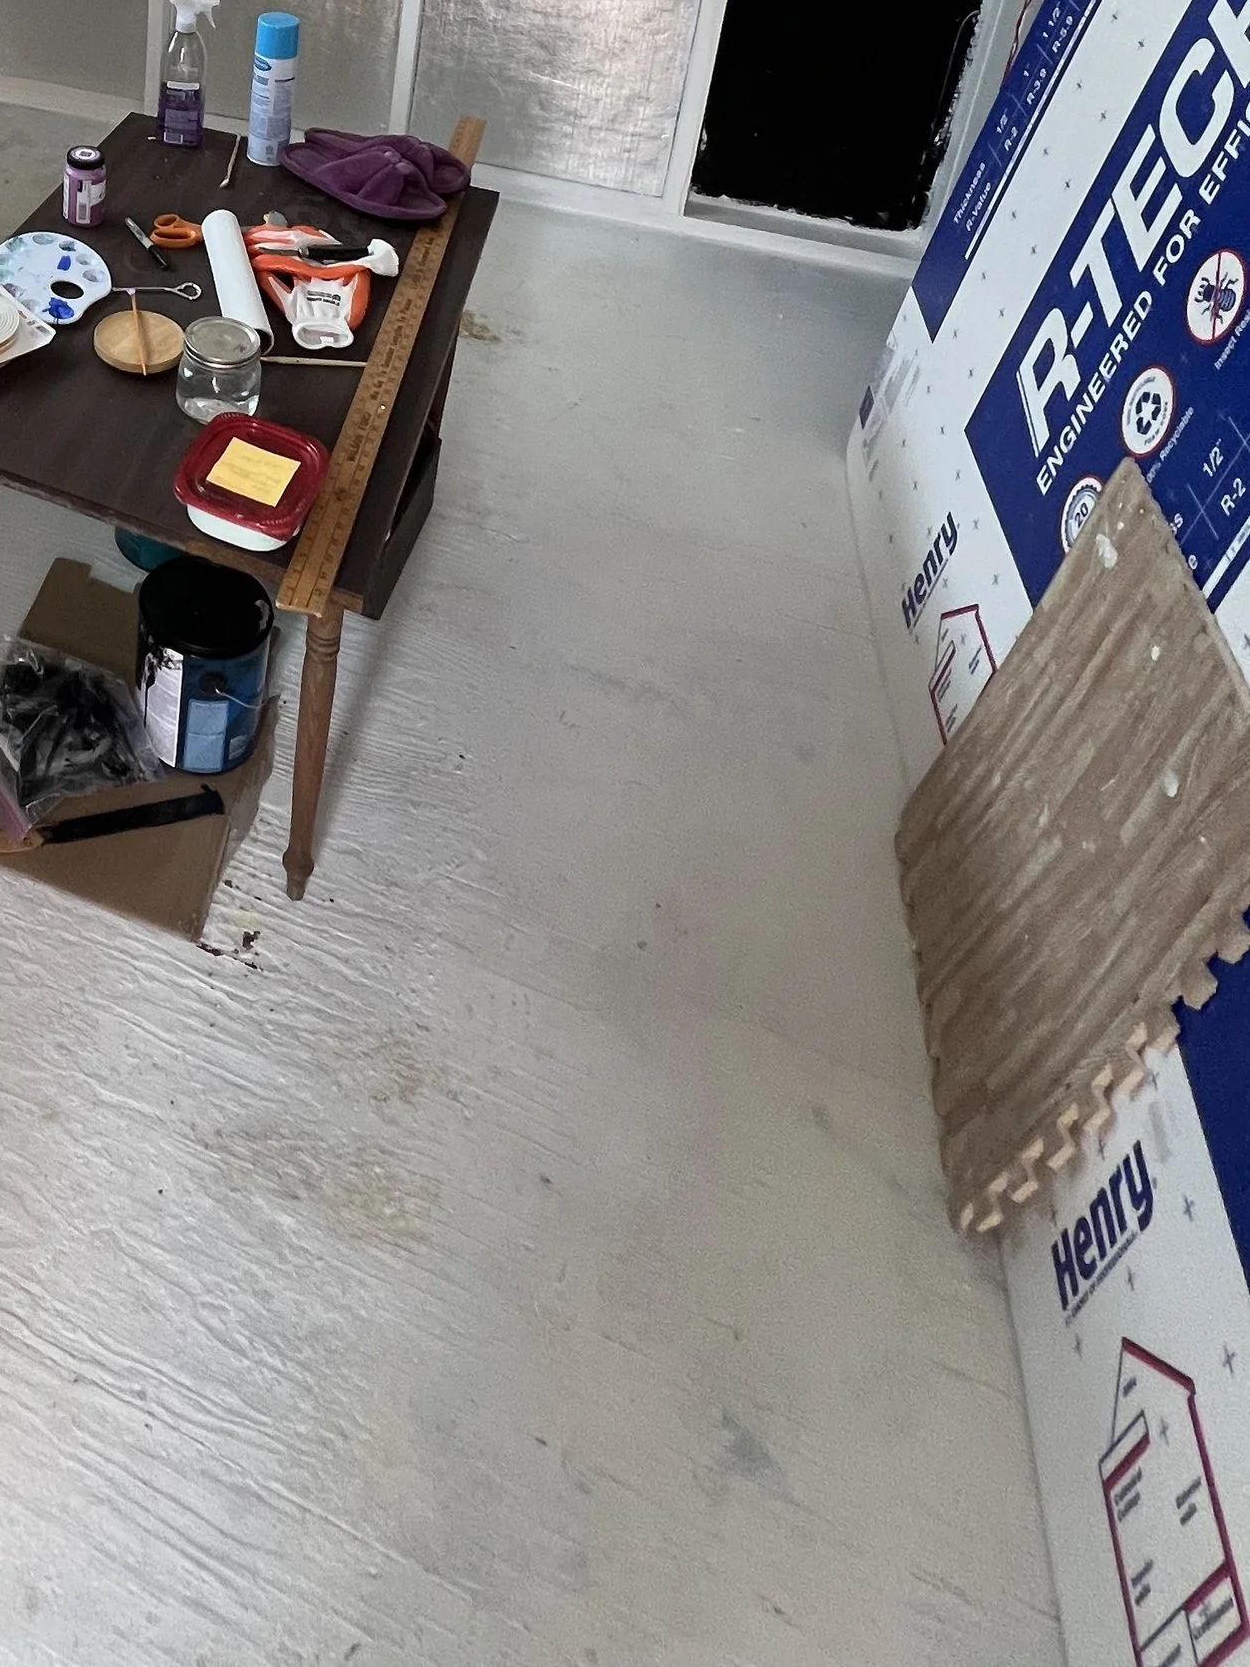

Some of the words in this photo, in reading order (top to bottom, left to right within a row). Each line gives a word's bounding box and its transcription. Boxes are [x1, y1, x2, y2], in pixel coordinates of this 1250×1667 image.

[953, 162, 985, 224] Thickness
[966, 182, 991, 231] R-Value
[1036, 290, 1152, 496] ENGINEERED
[1152, 208, 1201, 286] FOR
[1074, 502, 1089, 528] 20
[1220, 476, 1247, 516] R-2
[901, 511, 958, 630] Henry
[1051, 1139, 1154, 1311] Henry
